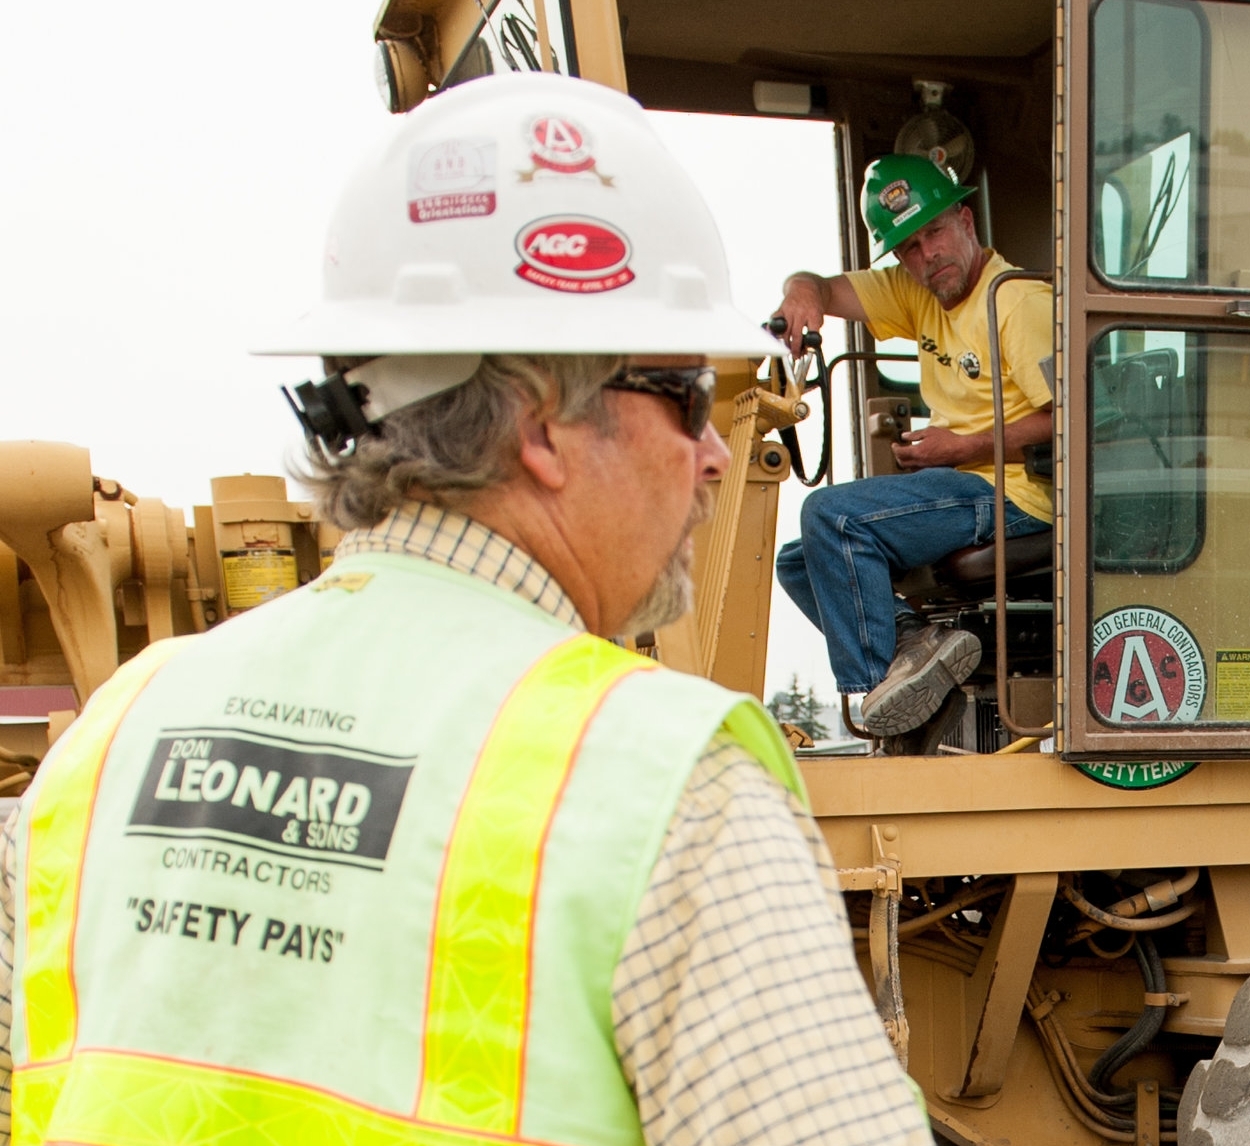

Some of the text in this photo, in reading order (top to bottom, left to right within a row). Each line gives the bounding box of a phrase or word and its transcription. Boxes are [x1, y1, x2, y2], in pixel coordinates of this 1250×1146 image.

[418, 205, 487, 220] Orientation
[526, 233, 588, 257] AGC
[1114, 612, 1166, 633] GENERAL
[1167, 625, 1202, 709] CONTRACTORS
[224, 696, 356, 733] EXCAVATING
[169, 739, 212, 759] DON
[1141, 761, 1186, 781] TEAM
[154, 759, 372, 827] LEONARD
[282, 819, 361, 852] & SONS
[162, 847, 332, 894] CONTRACTORS
[127, 896, 344, 964] "SAFETY PAYS"
